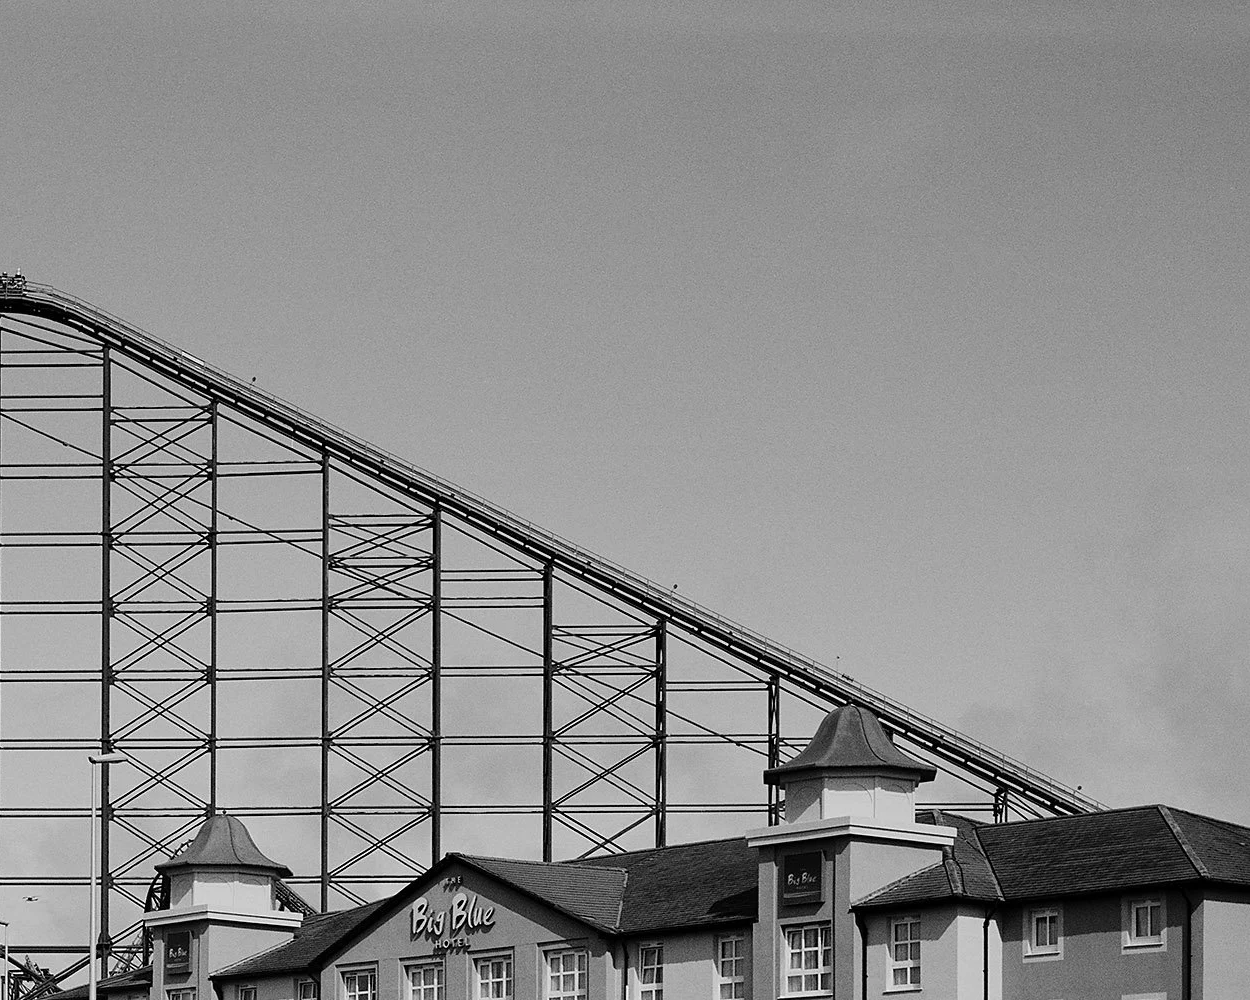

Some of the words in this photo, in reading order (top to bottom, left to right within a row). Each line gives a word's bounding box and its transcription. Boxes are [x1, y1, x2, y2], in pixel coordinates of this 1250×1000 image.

[412, 897, 445, 936] Big
[452, 893, 493, 930] Blue
[435, 938, 469, 948] HOTEL
